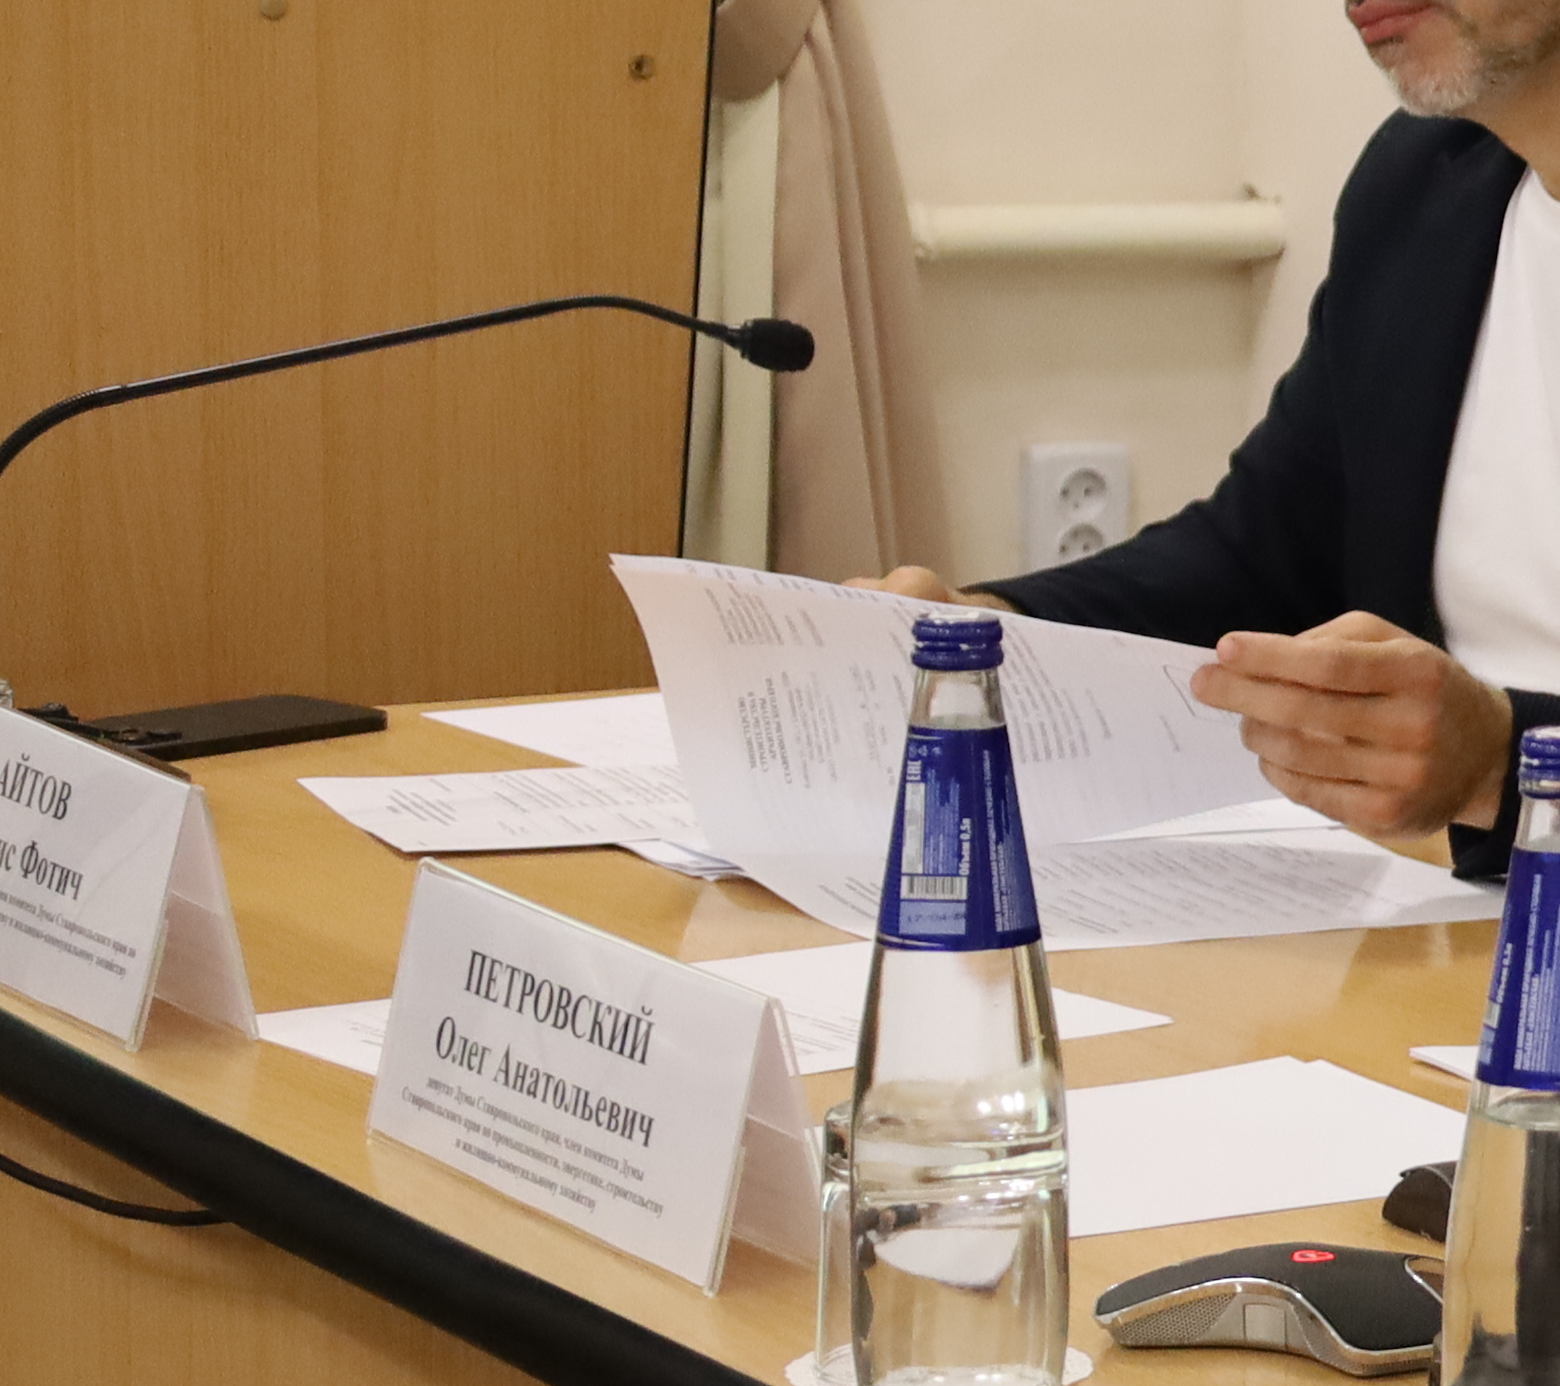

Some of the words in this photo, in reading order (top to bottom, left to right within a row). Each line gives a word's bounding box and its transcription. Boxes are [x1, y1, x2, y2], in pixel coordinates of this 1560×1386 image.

[20, 840, 84, 901] Фотич
[464, 948, 656, 1066] ПЕТРОВСКИЙ
[435, 1016, 492, 1076] Олег
[492, 1043, 656, 1149] Анатольевич
